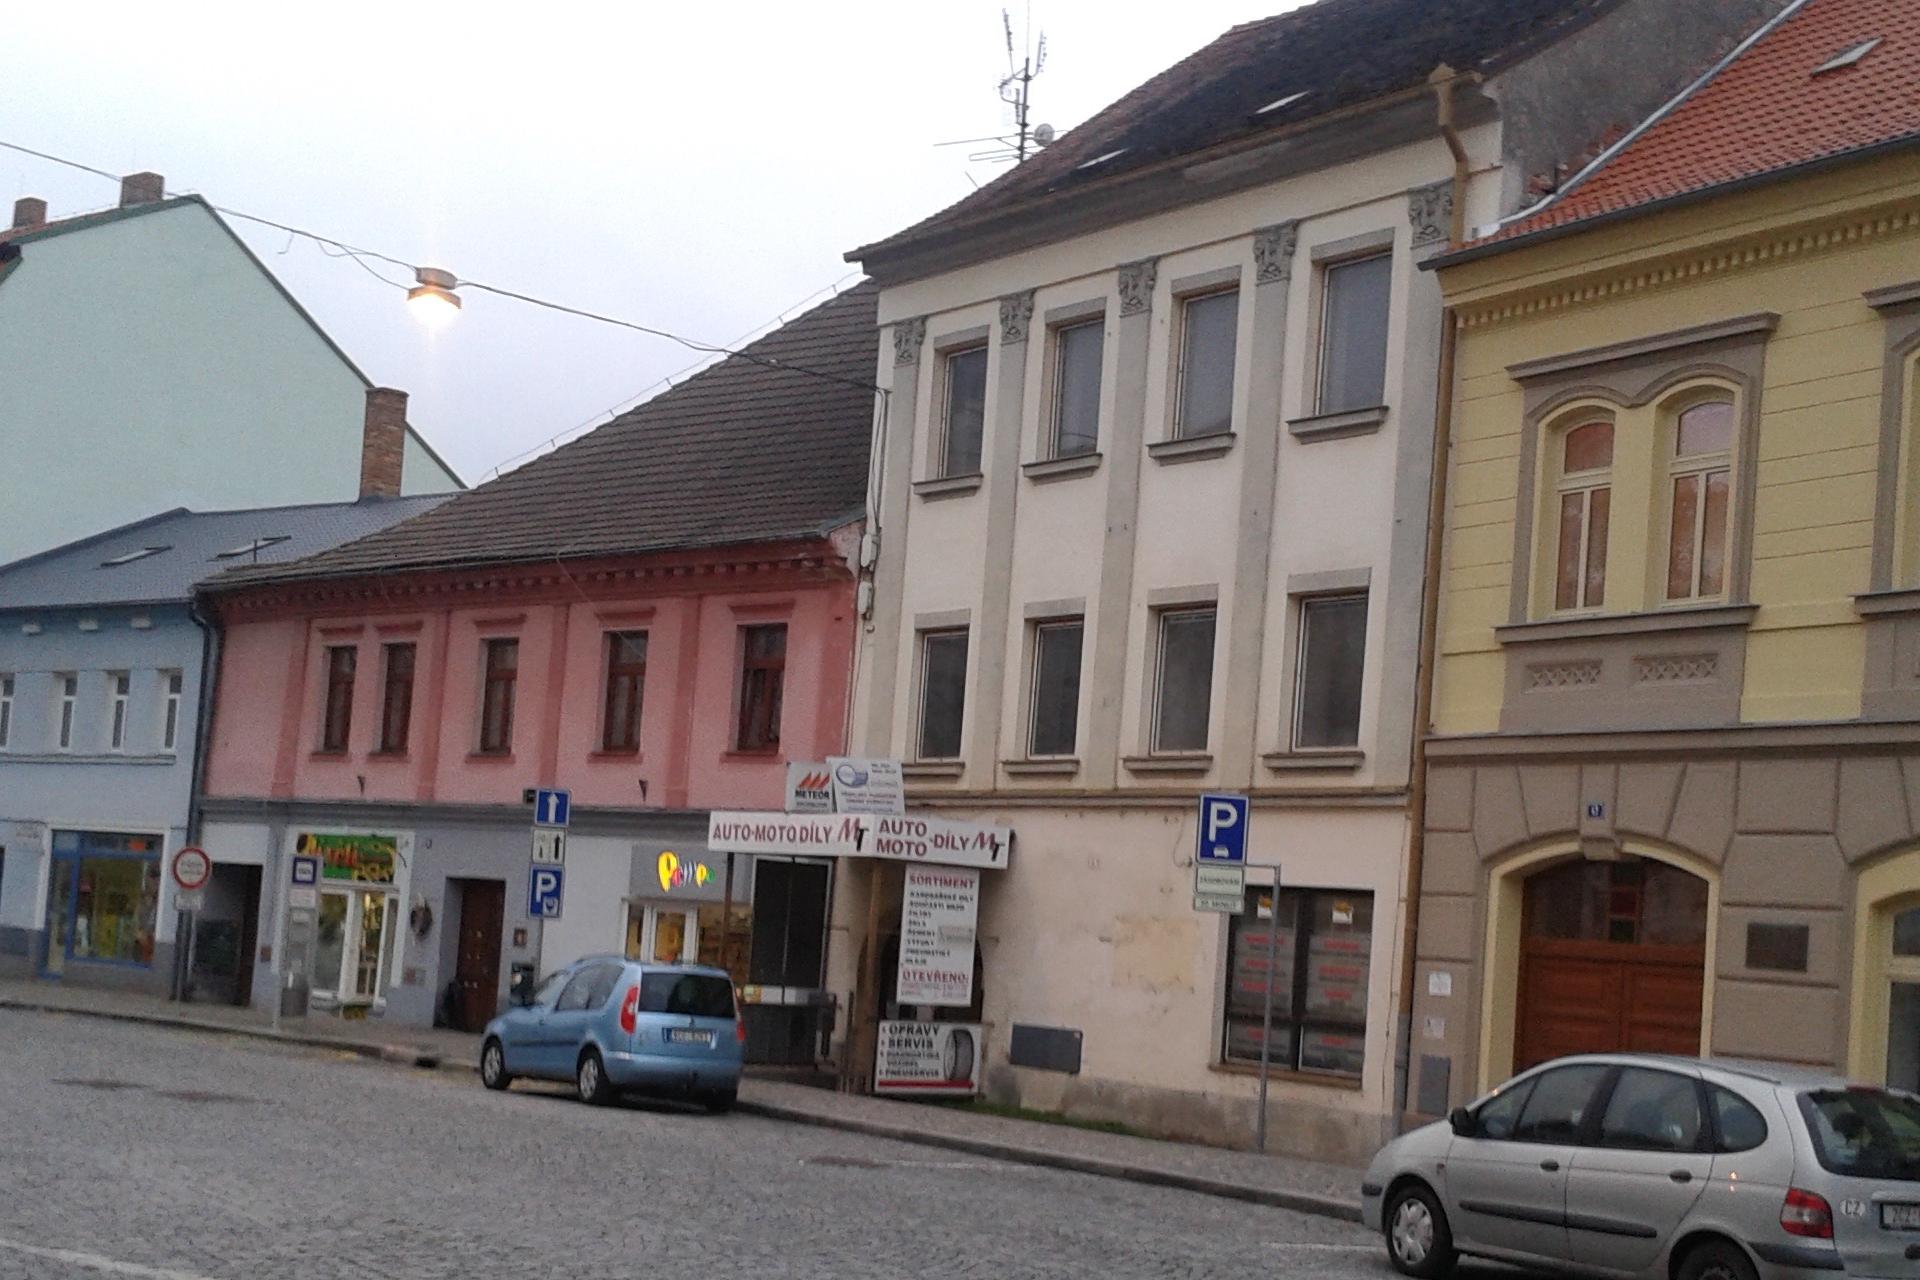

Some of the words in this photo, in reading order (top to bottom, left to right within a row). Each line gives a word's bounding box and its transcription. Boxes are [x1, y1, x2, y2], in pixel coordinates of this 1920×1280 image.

[795, 789, 830, 800] METEOR
[879, 819, 928, 837] AUTO
[1208, 801, 1237, 842] P
[877, 837, 928, 857] MOTO
[536, 872, 557, 903] P
[909, 875, 976, 889] SORTIMENT
[889, 1023, 940, 1037] OPRAVY
